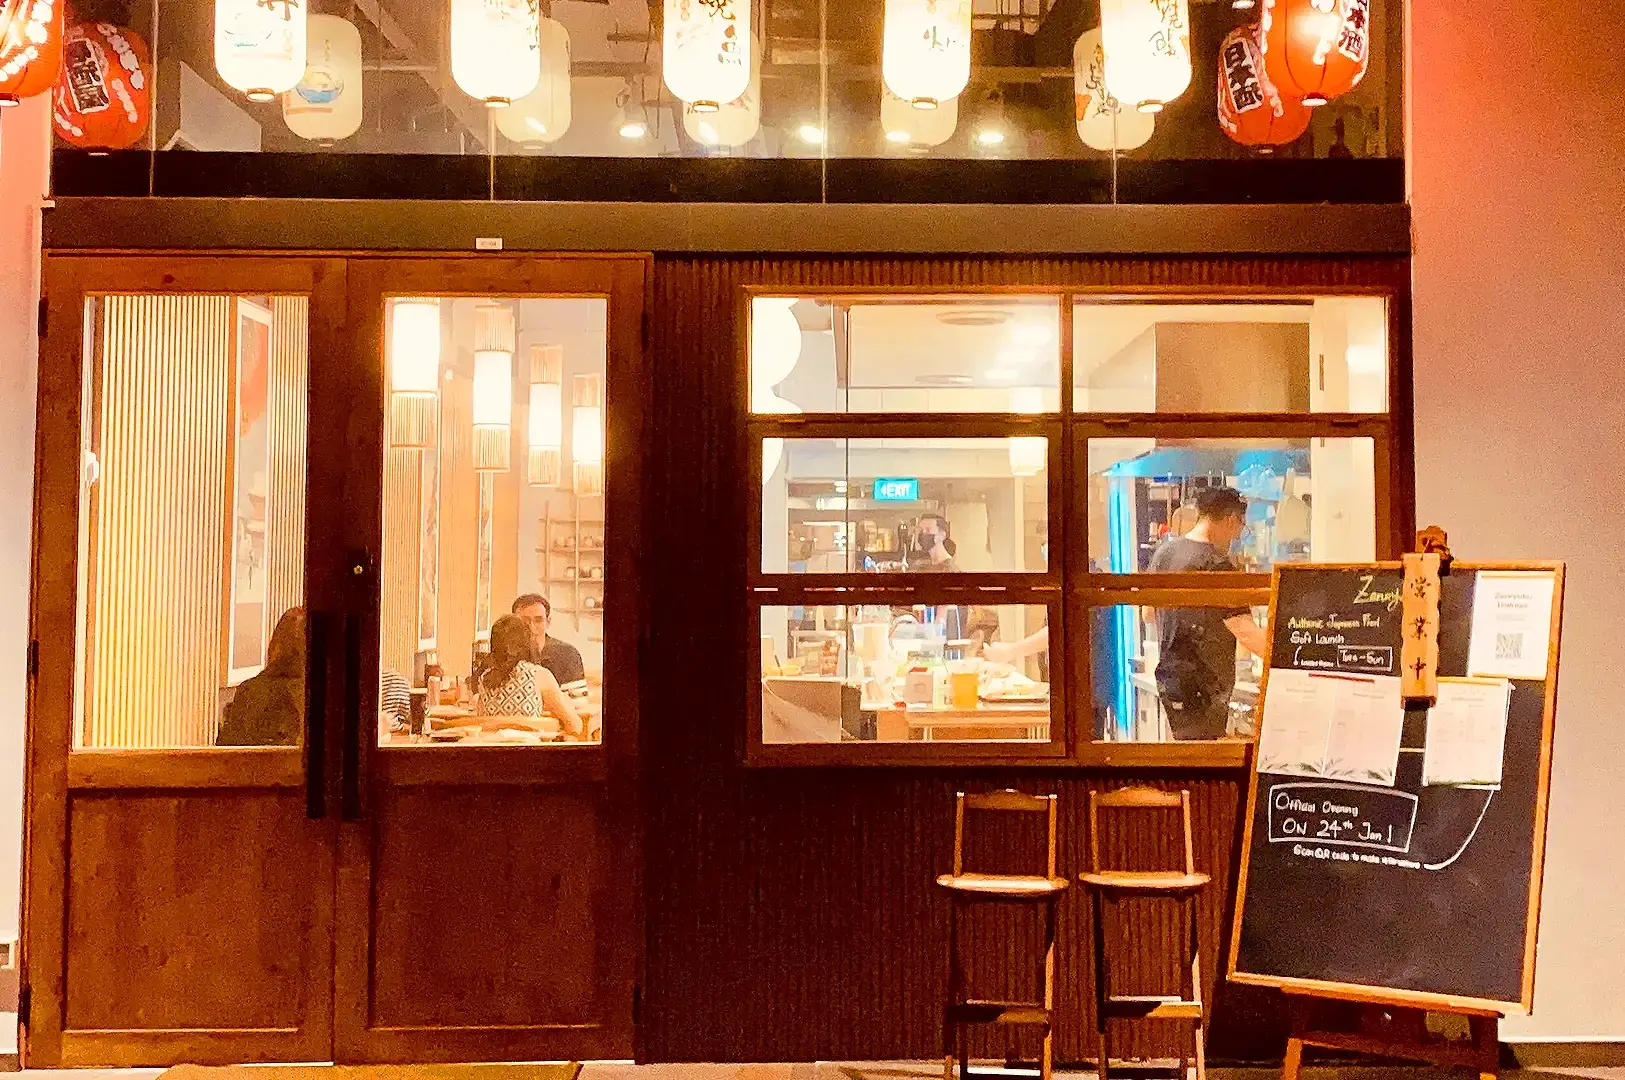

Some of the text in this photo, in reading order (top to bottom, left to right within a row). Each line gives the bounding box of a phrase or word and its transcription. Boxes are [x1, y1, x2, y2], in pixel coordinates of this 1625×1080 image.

[1339, 0, 1368, 58] 本酒
[887, 482, 912, 498] EXIT
[1290, 630, 1344, 644] Soft Launch
[1275, 792, 1359, 818] Official Opening
[1293, 843, 1314, 857] Scan
[1314, 847, 1330, 860] QR
